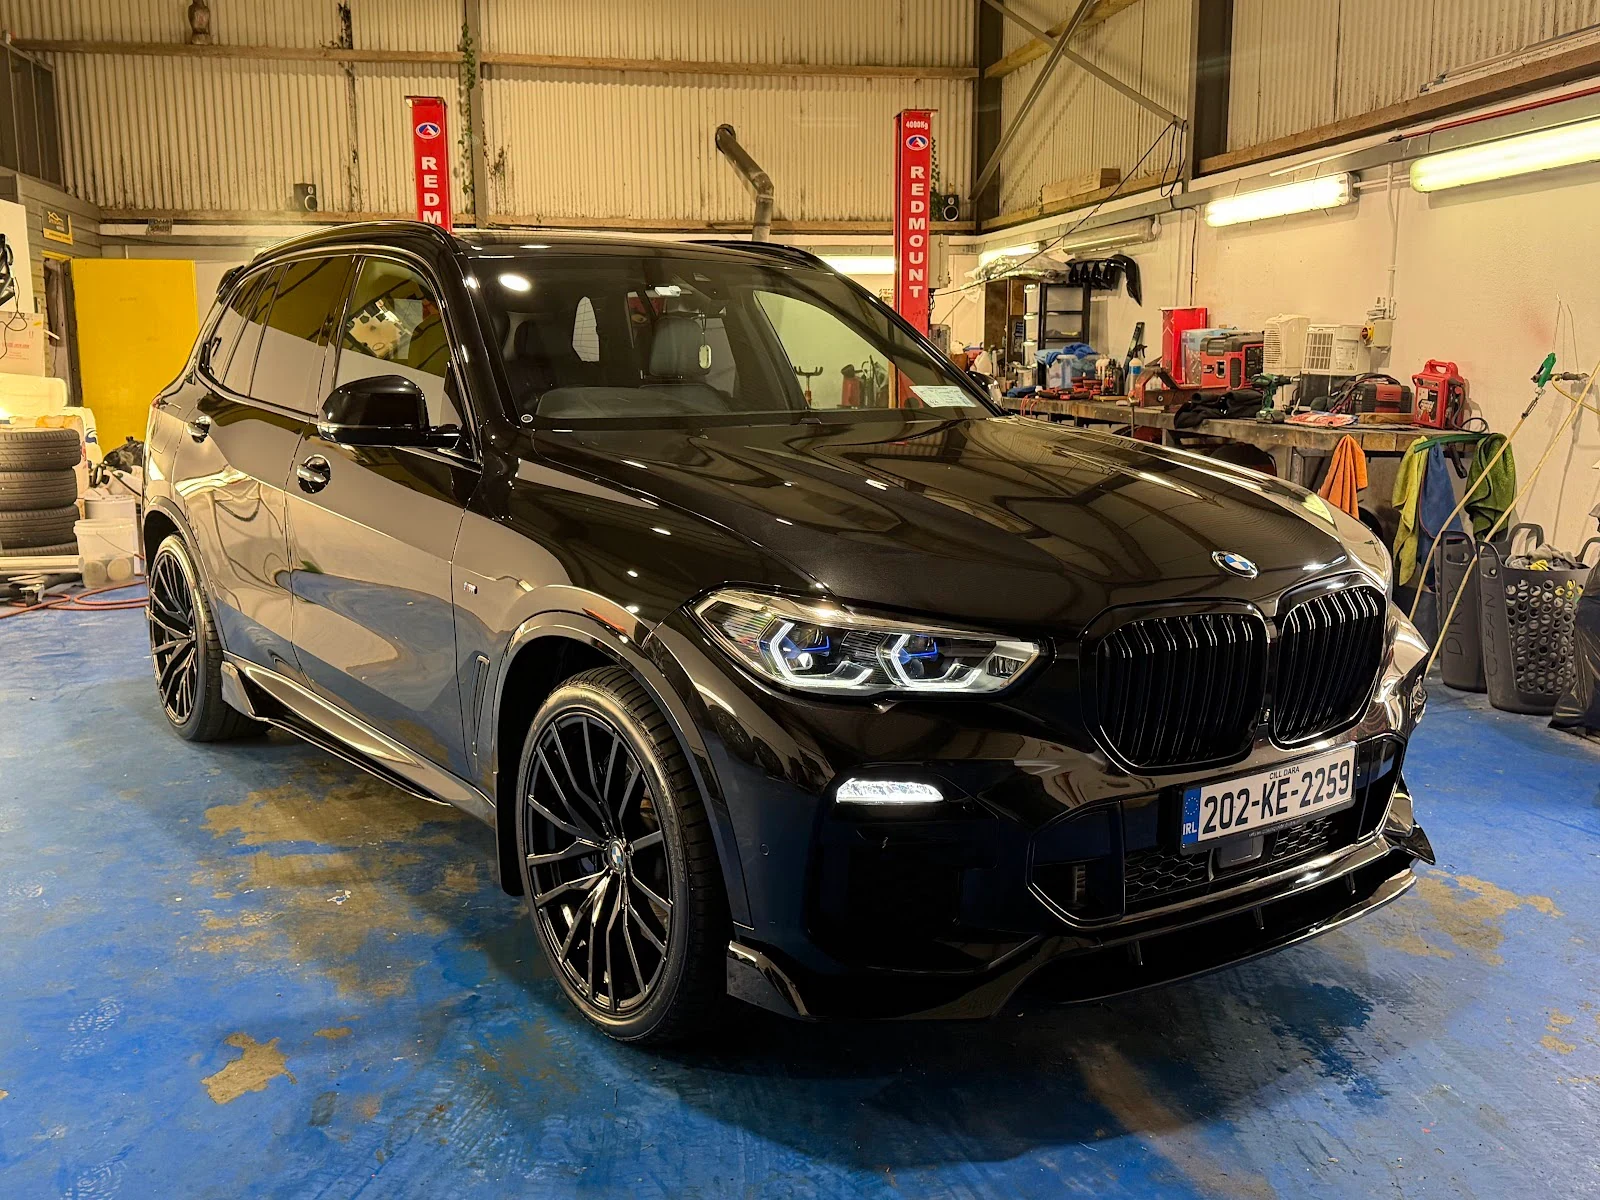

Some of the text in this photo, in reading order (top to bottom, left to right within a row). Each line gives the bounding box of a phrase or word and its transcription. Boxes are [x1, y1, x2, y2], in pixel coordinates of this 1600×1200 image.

[908, 166, 926, 298] REDMOUNT
[1484, 593, 1498, 676] CLEAN
[1202, 760, 1350, 835] 202-KE-2259
[1269, 766, 1300, 780] CILL DARA
[1182, 822, 1198, 836] IRL
